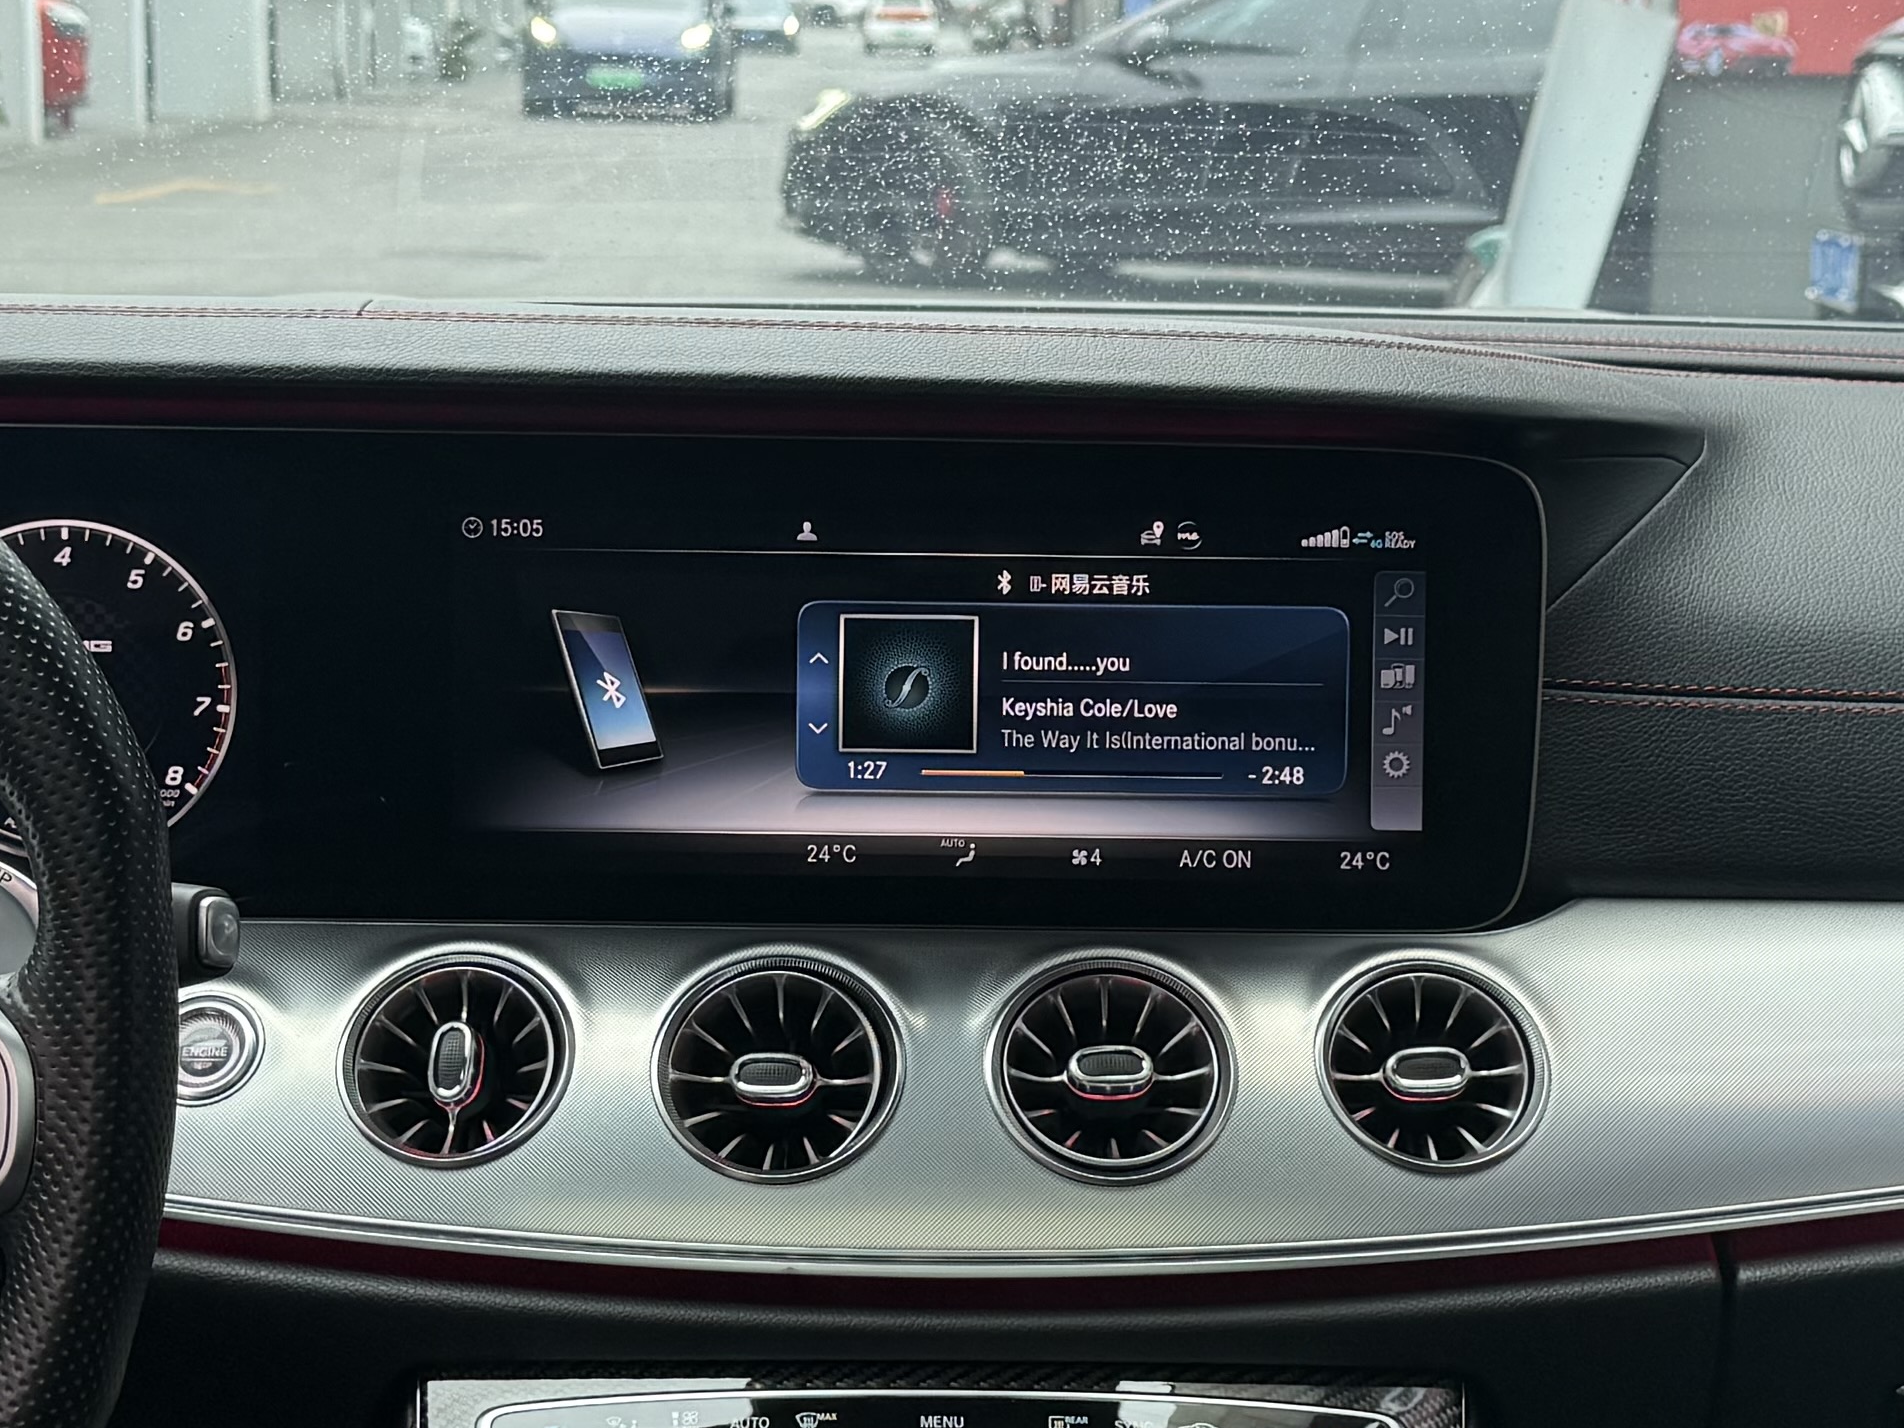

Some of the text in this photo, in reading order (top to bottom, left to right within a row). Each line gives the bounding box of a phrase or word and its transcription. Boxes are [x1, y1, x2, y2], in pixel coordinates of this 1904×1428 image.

[490, 518, 543, 538] 15:05
[1384, 539, 1416, 549] READY
[53, 546, 72, 567] 4
[126, 569, 146, 589] 5
[1050, 573, 1151, 596] 网易云音乐
[176, 621, 194, 641] 6
[1002, 651, 1008, 670] I
[193, 697, 212, 716] 7
[1001, 697, 1178, 721] Keyshia Cole/Love
[1001, 729, 1316, 753] The Way It Is(International bonu...
[164, 765, 184, 786] 8
[847, 760, 887, 780] 1:27
[940, 838, 966, 849] AUTO
[806, 844, 857, 863] 24°C
[1090, 849, 1102, 866] 4
[1179, 850, 1252, 869] A/C ON
[1339, 851, 1391, 870] 24°C
[816, 1412, 838, 1422] MAX
[1064, 1416, 1089, 1425] REAR
